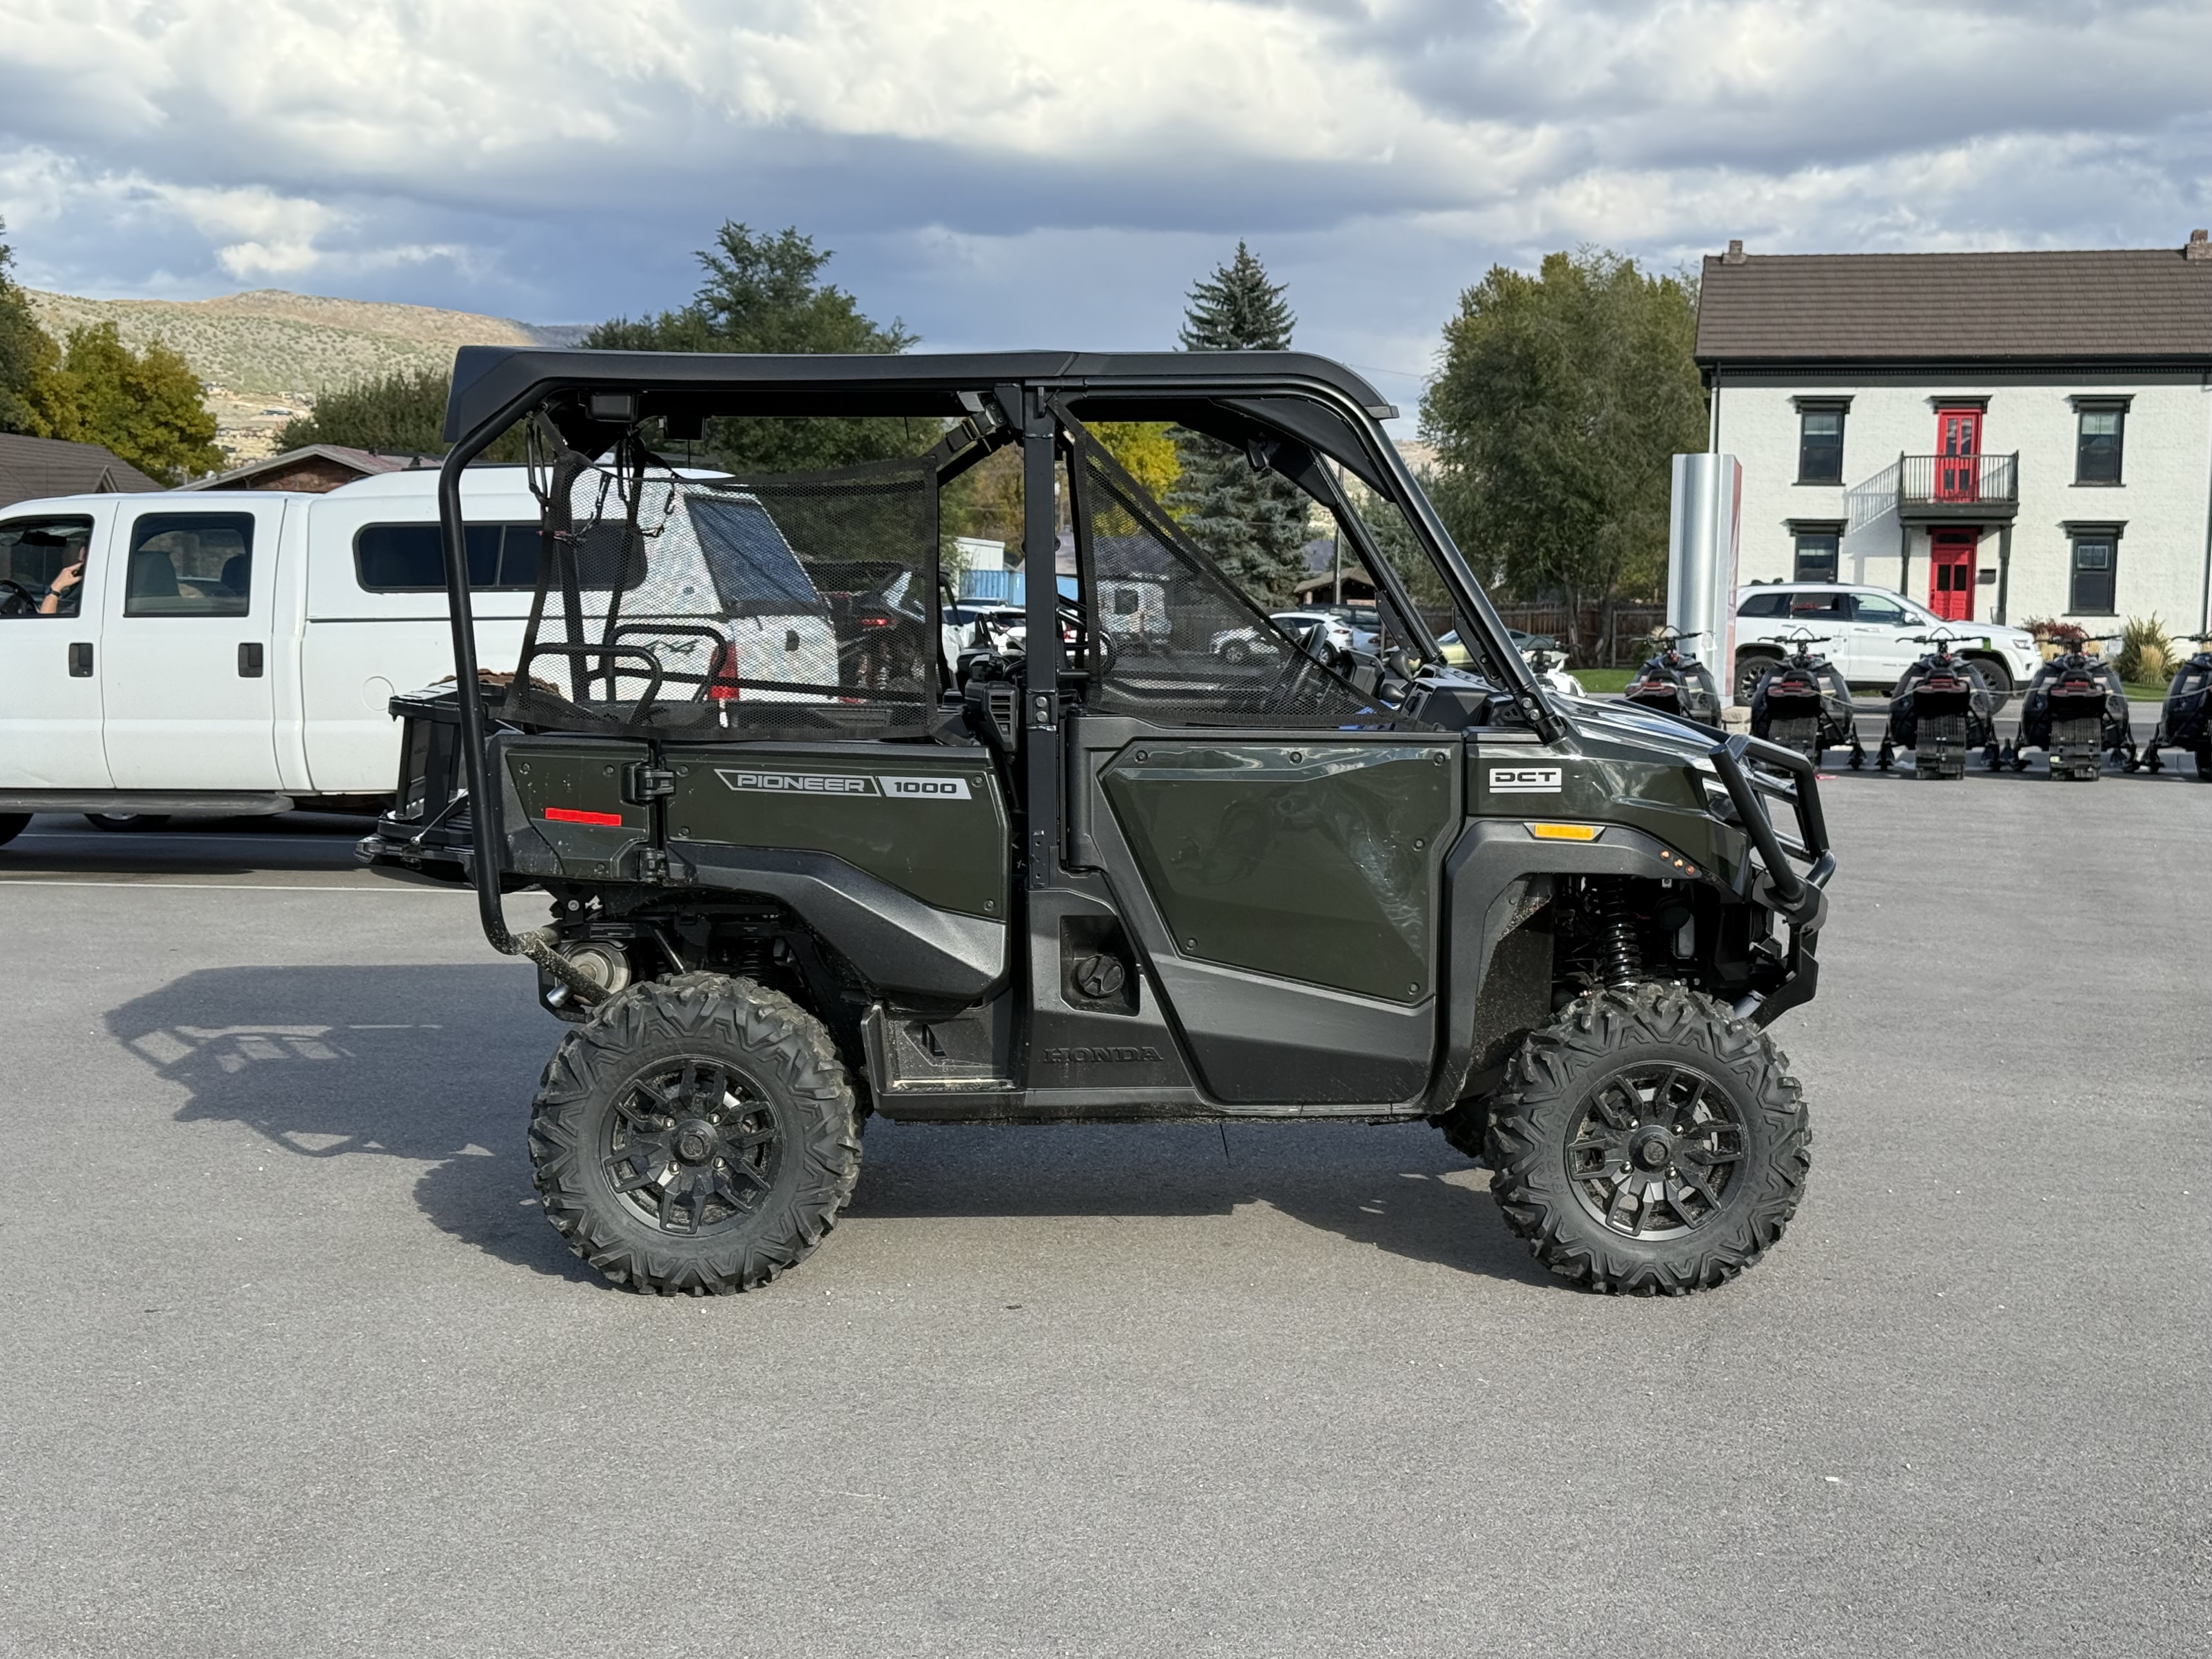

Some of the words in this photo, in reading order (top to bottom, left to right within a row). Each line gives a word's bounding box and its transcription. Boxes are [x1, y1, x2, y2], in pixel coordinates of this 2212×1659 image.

[737, 774, 865, 793] PIONEER
[893, 781, 958, 794] 1000
[1495, 772, 1556, 782] DCT
[1043, 1046, 1164, 1063] HONDA
